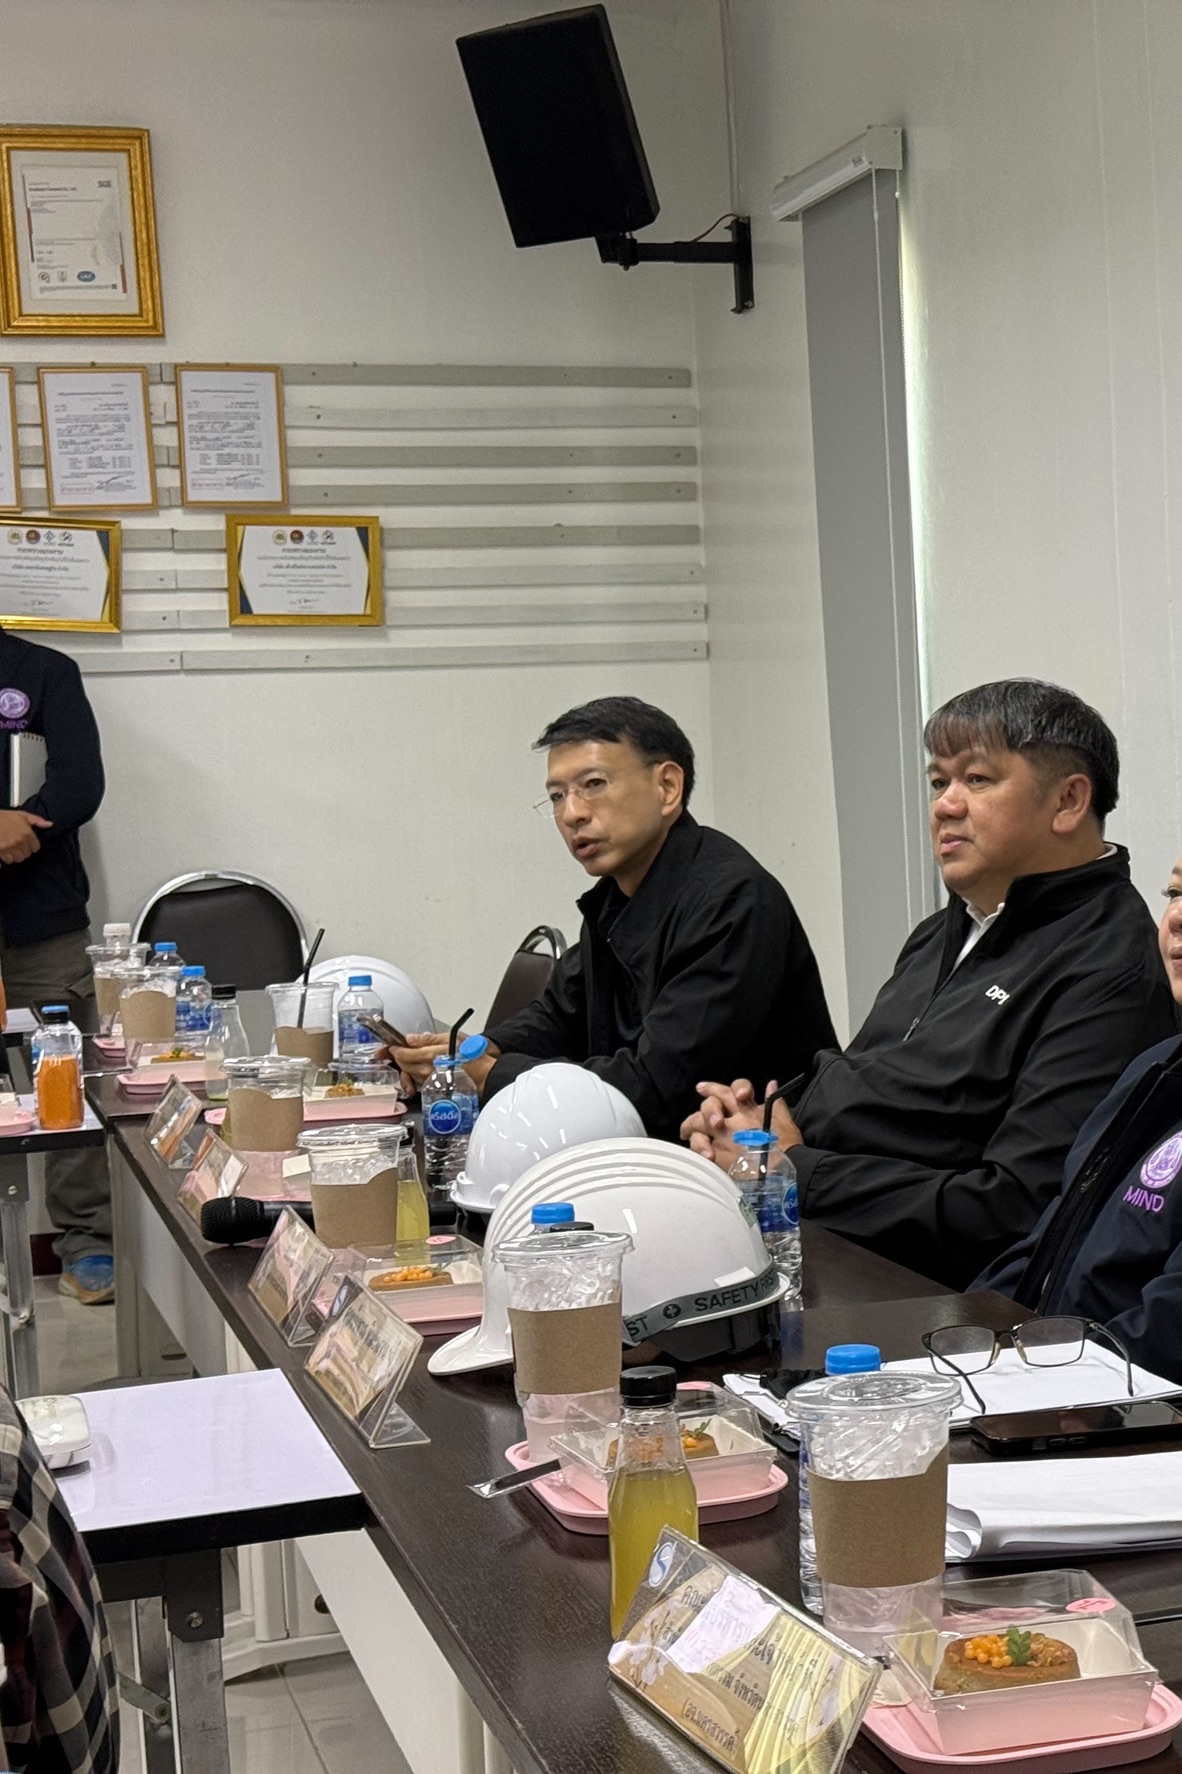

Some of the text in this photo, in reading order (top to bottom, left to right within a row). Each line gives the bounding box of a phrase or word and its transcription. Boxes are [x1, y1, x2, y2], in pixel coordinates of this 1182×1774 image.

[985, 984, 1010, 1005] DPI
[1123, 1185, 1165, 1212] MIND
[694, 1283, 760, 1311] SAFETY
